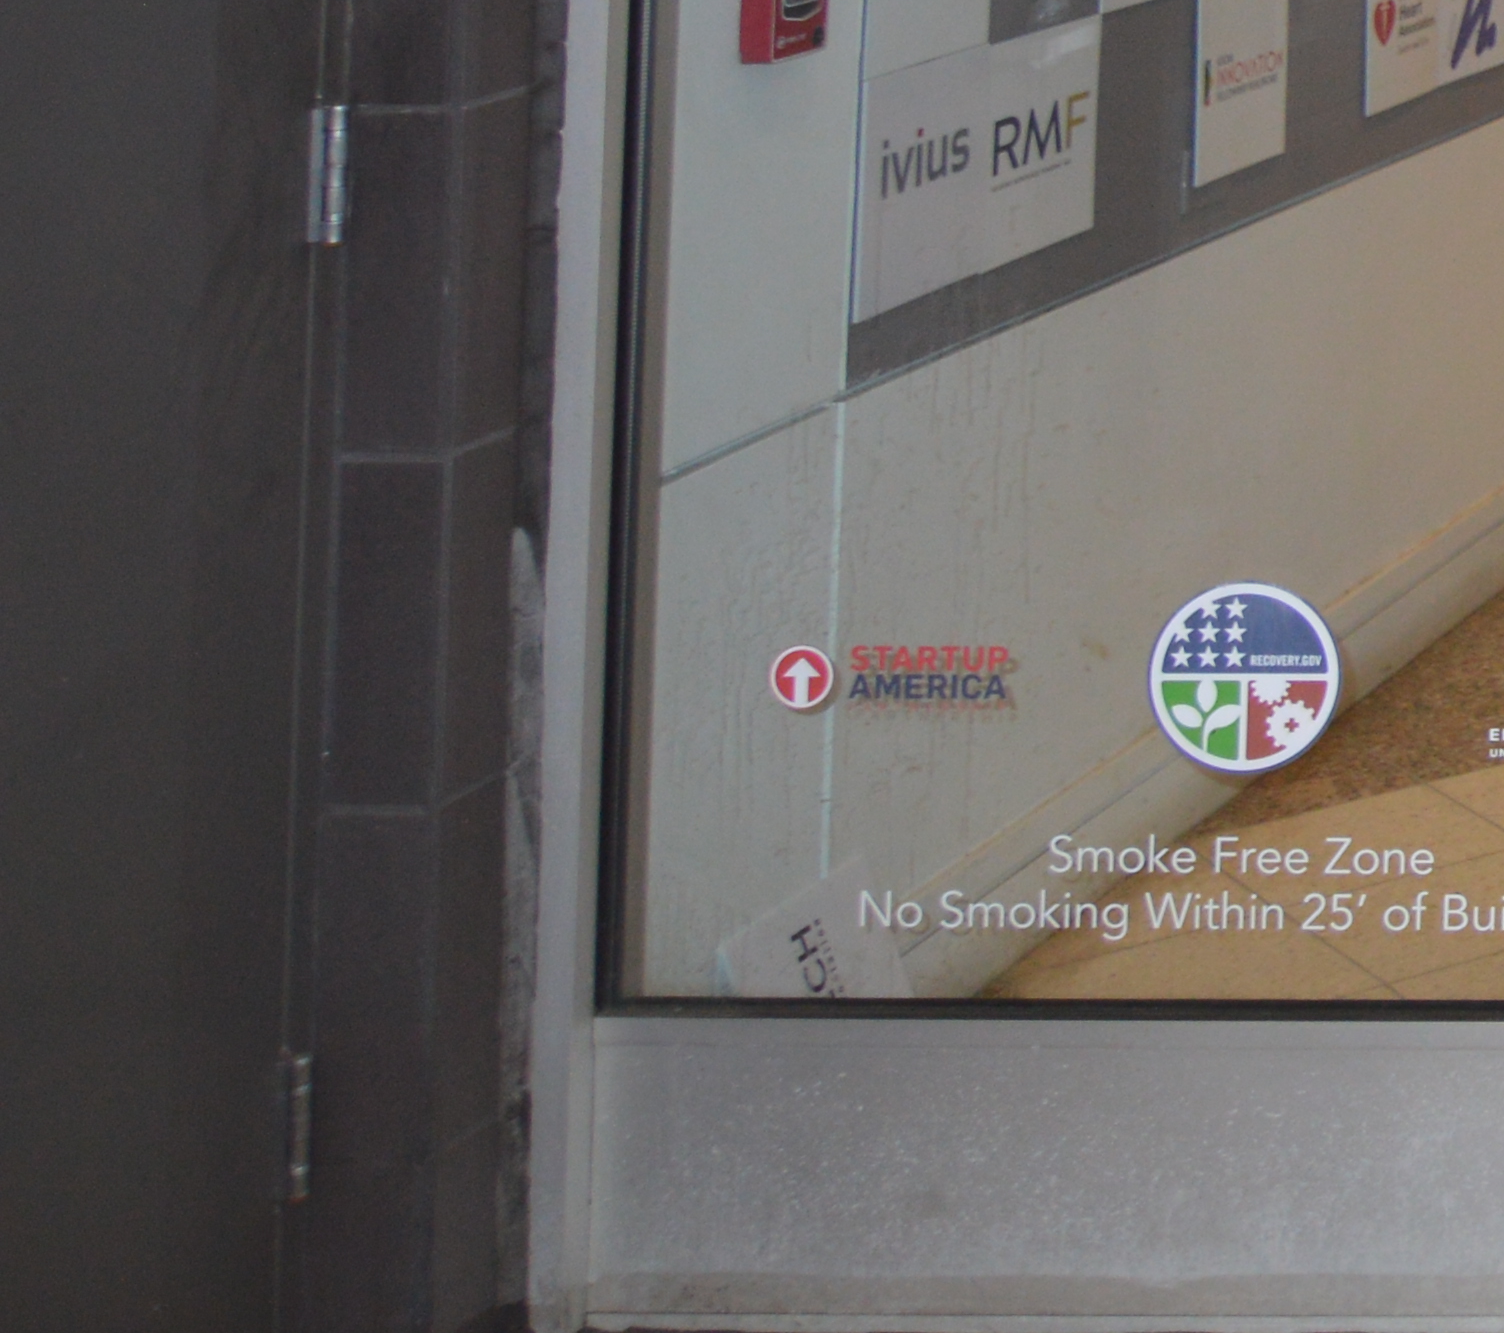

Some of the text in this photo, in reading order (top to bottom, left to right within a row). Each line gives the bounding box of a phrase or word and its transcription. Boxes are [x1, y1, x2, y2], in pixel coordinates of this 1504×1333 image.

[880, 90, 1091, 199] ivius RMF
[850, 645, 1010, 673] STARTUP
[1249, 654, 1323, 668] RECOVERY.GOV
[848, 673, 1008, 701] AMERICA
[1049, 833, 1436, 876] Smoke Free Zone
[858, 889, 924, 929] No
[939, 889, 1130, 940] Smoking
[1144, 890, 1285, 931] Within
[1300, 893, 1368, 932] 25'
[1382, 891, 1428, 932] of
